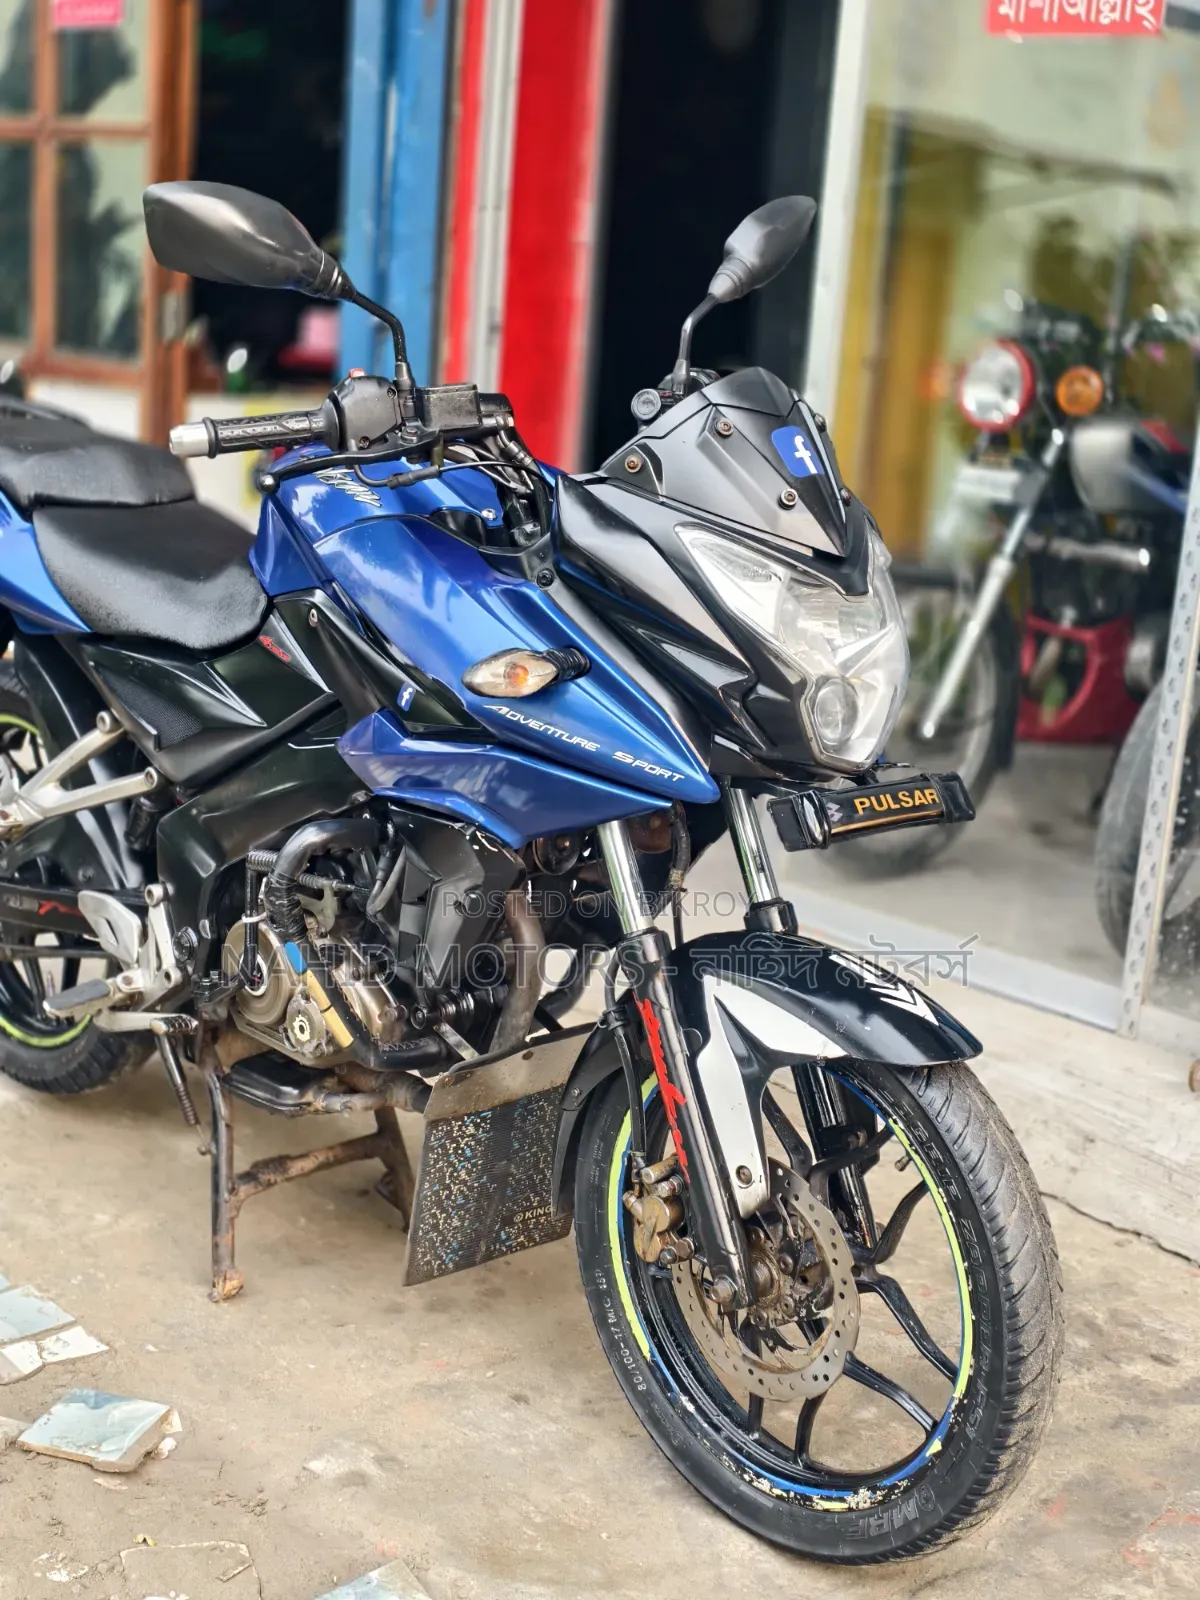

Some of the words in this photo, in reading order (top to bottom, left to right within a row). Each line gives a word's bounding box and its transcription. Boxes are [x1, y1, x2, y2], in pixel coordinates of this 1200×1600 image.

[483, 704, 601, 752] ADVENTURE
[612, 750, 685, 782] SPORT
[853, 788, 940, 815] PULSAR
[524, 1205, 554, 1221] KING
